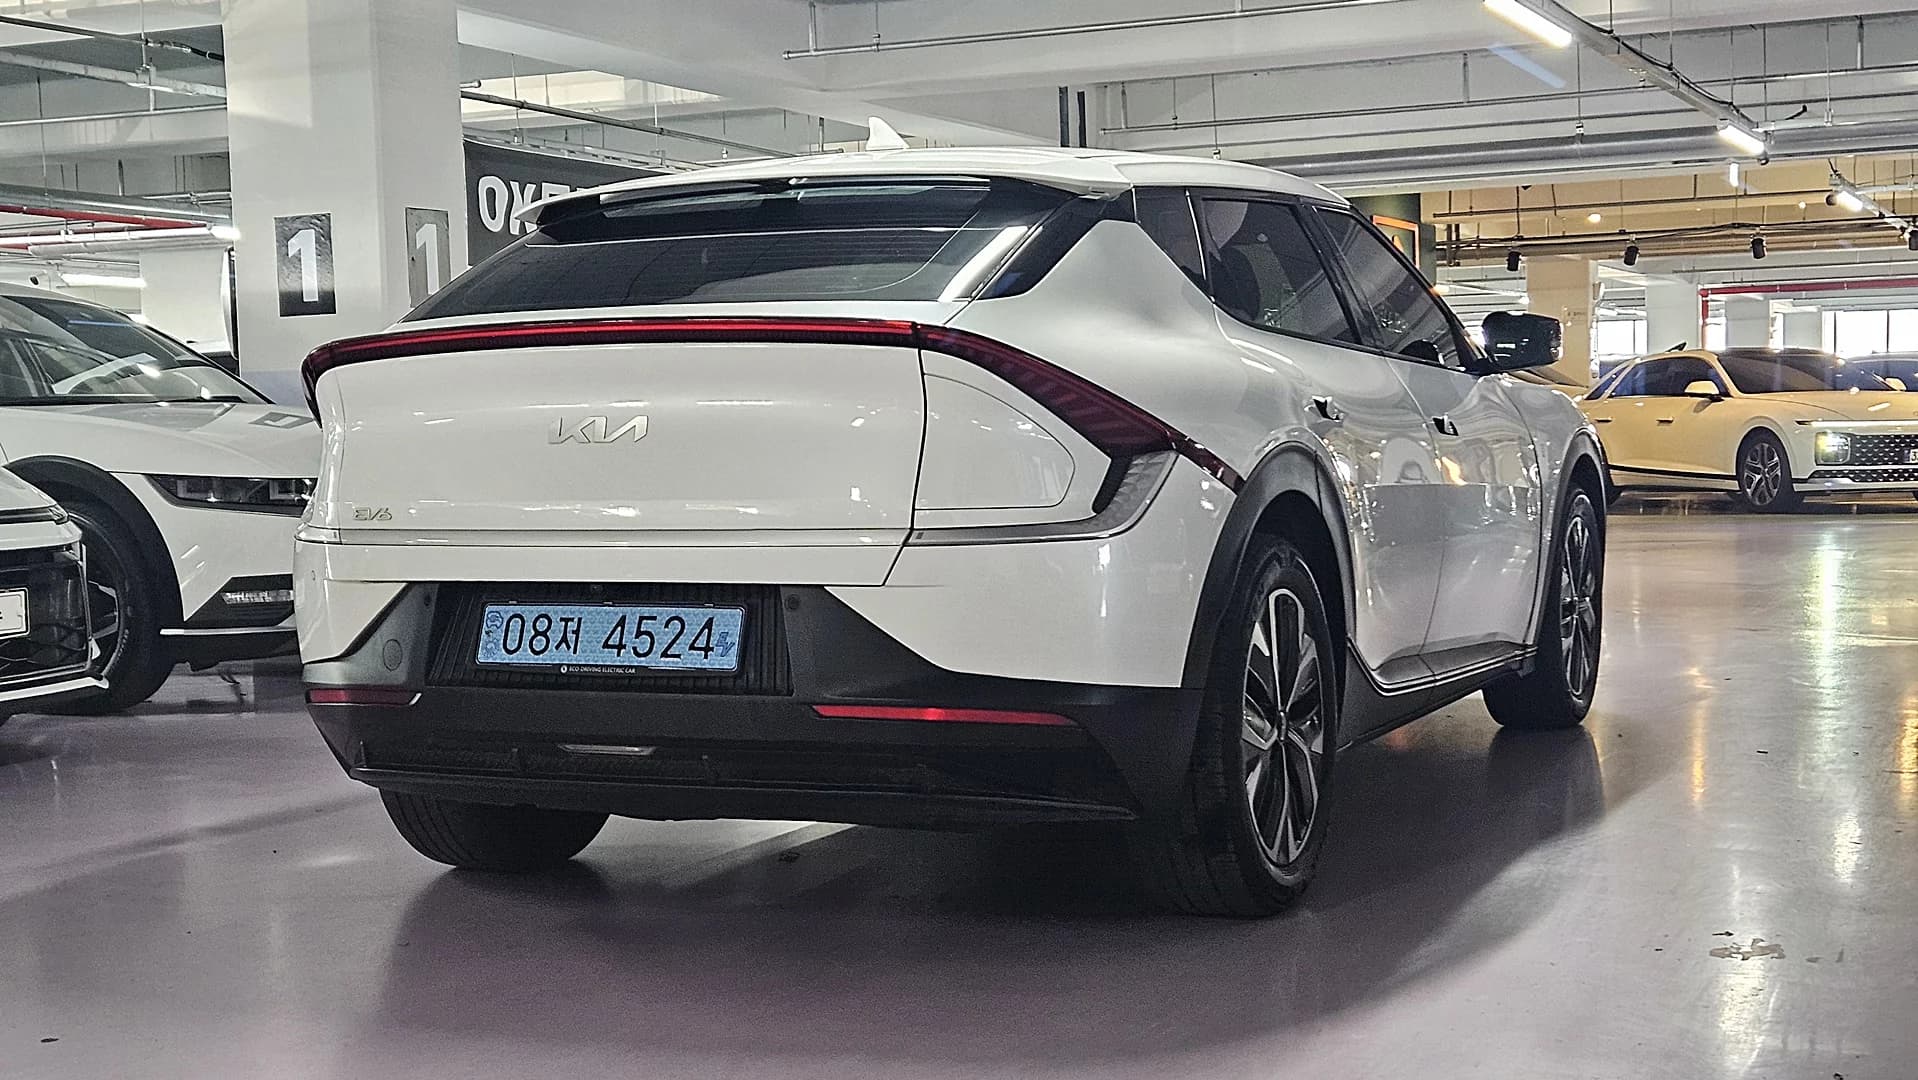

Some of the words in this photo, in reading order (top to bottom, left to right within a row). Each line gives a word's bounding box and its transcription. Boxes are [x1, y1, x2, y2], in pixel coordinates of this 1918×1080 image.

[287, 228, 319, 302] 1
[415, 223, 440, 296] 1
[547, 415, 649, 444] KIA
[352, 506, 392, 521] EV6
[502, 612, 582, 656] 08저
[601, 614, 716, 660] 4524
